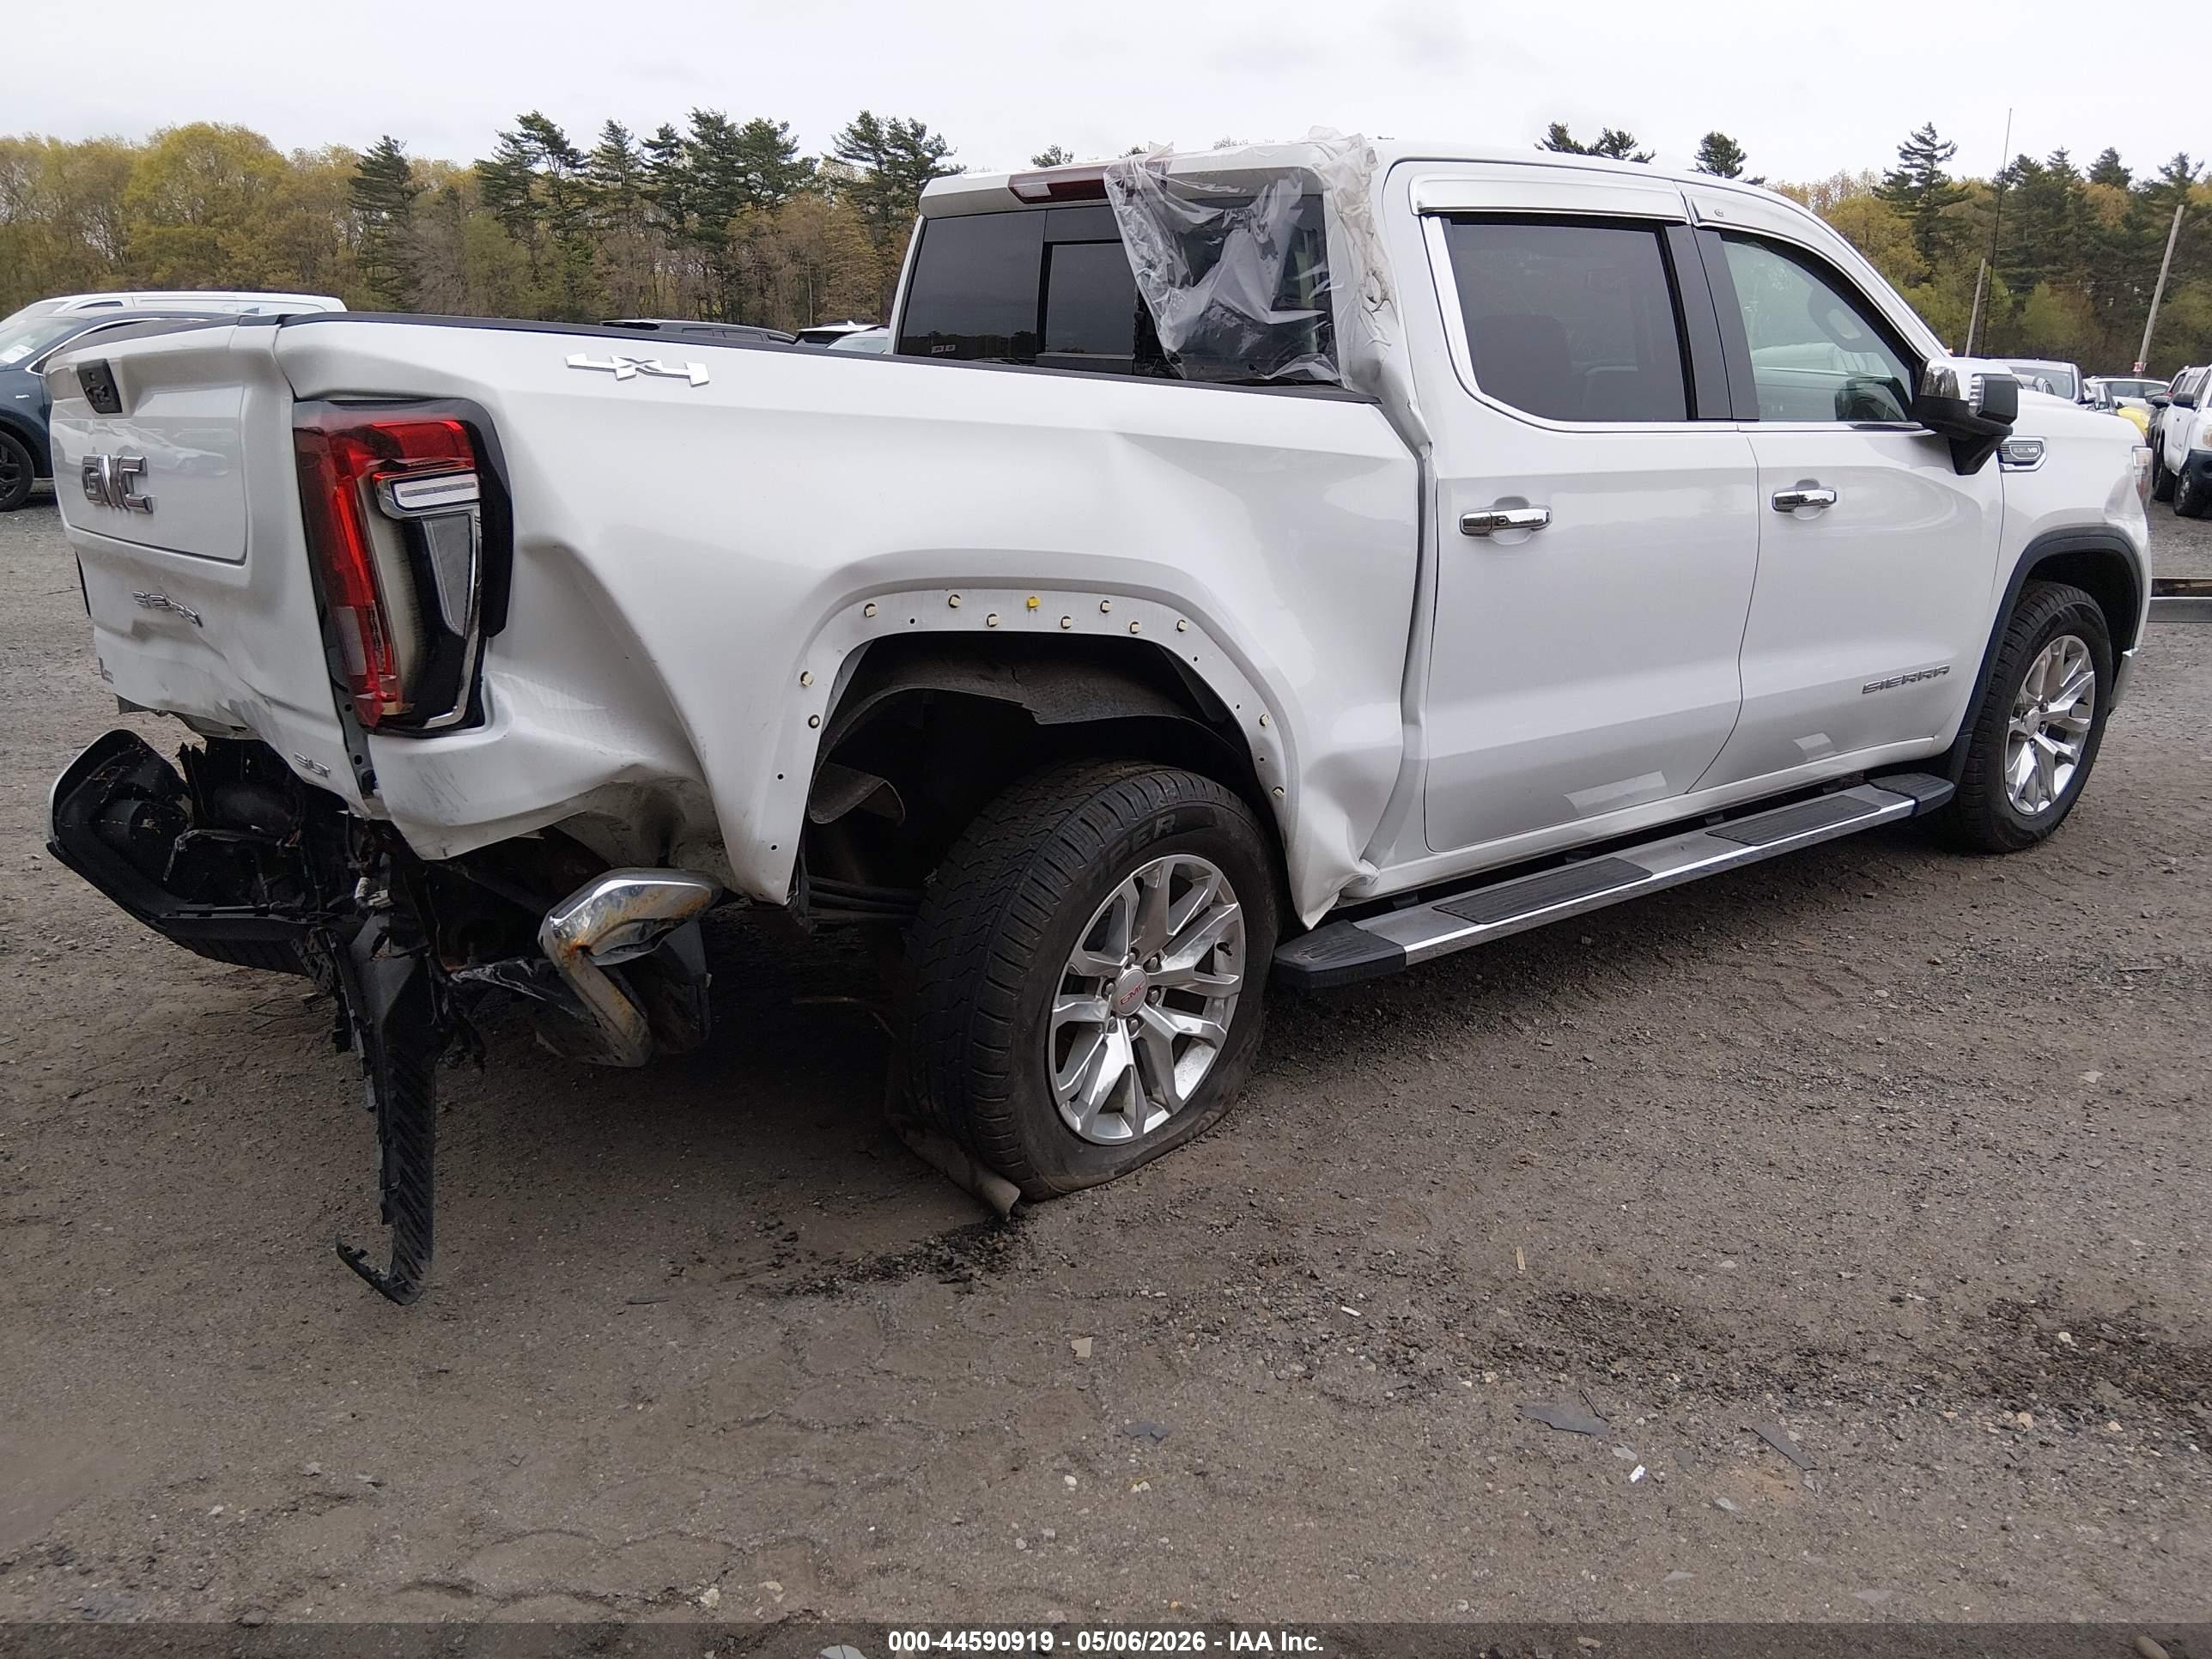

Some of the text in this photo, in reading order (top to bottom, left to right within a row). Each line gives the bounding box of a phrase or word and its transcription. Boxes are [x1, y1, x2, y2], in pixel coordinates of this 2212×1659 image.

[82, 454, 154, 515] GMC
[1862, 664, 1950, 695] SIERRA
[1120, 979, 1146, 1005] GMC
